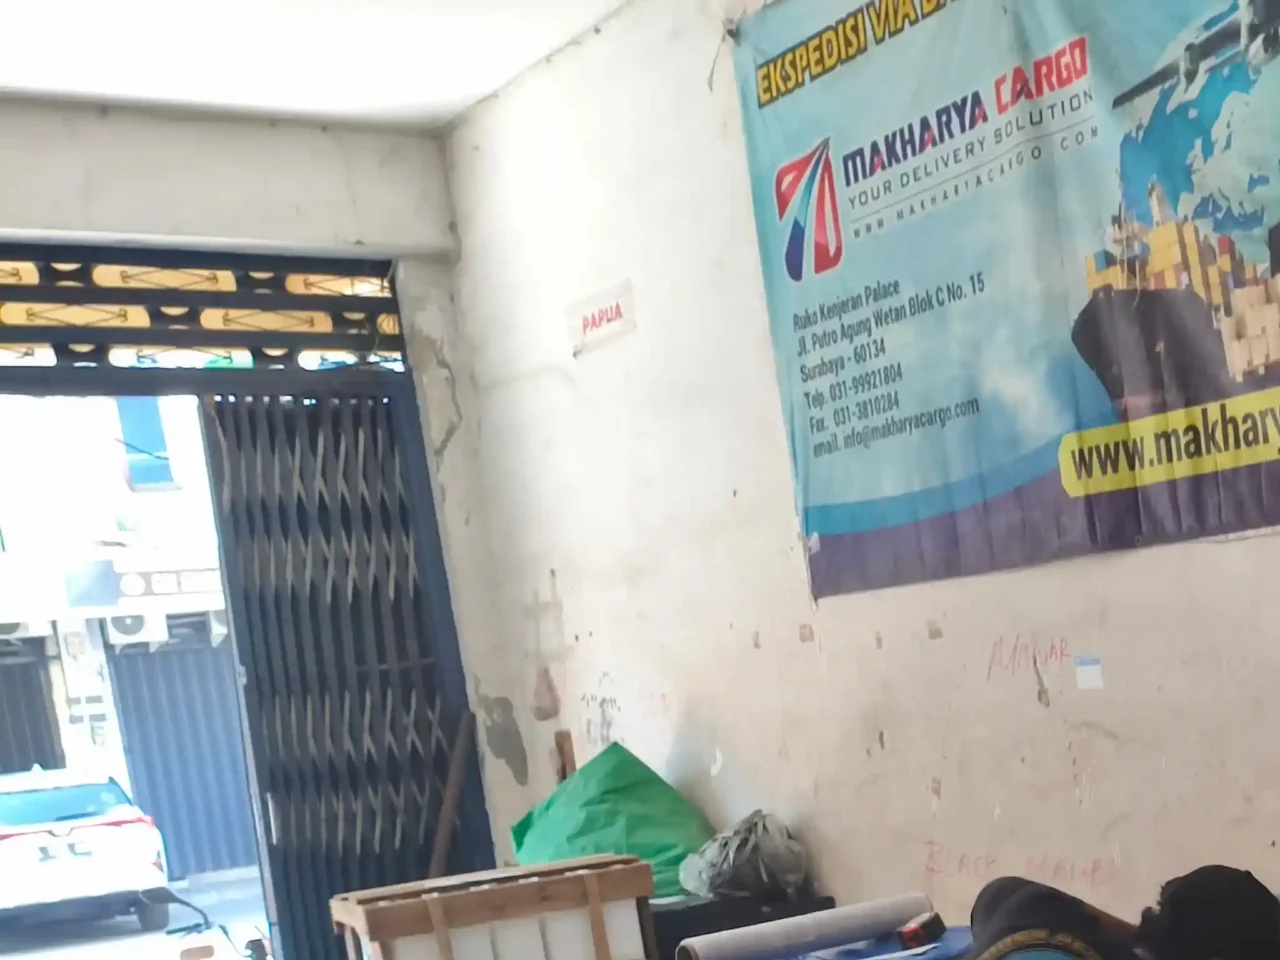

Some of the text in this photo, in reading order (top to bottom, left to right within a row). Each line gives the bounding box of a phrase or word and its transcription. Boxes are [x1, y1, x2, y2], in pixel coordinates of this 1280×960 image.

[757, 0, 920, 109] EKSPEDISI VIA
[842, 35, 1088, 188] MAKHARYA CARGO
[848, 87, 1095, 210] YOUR DELIVERY SOLUTION
[582, 300, 624, 336] PAPUA
[793, 279, 900, 333] Ruko Kenjeran Palace
[798, 271, 985, 357] Jl. Putro Agung Wetan Blok C No. 15
[800, 355, 845, 384] Surabaya
[854, 336, 886, 365] 60134
[804, 362, 903, 411] Telp. 031-99921804
[809, 390, 900, 435] Fax. 031-3810284
[843, 397, 980, 449] info@makharyacargo.com
